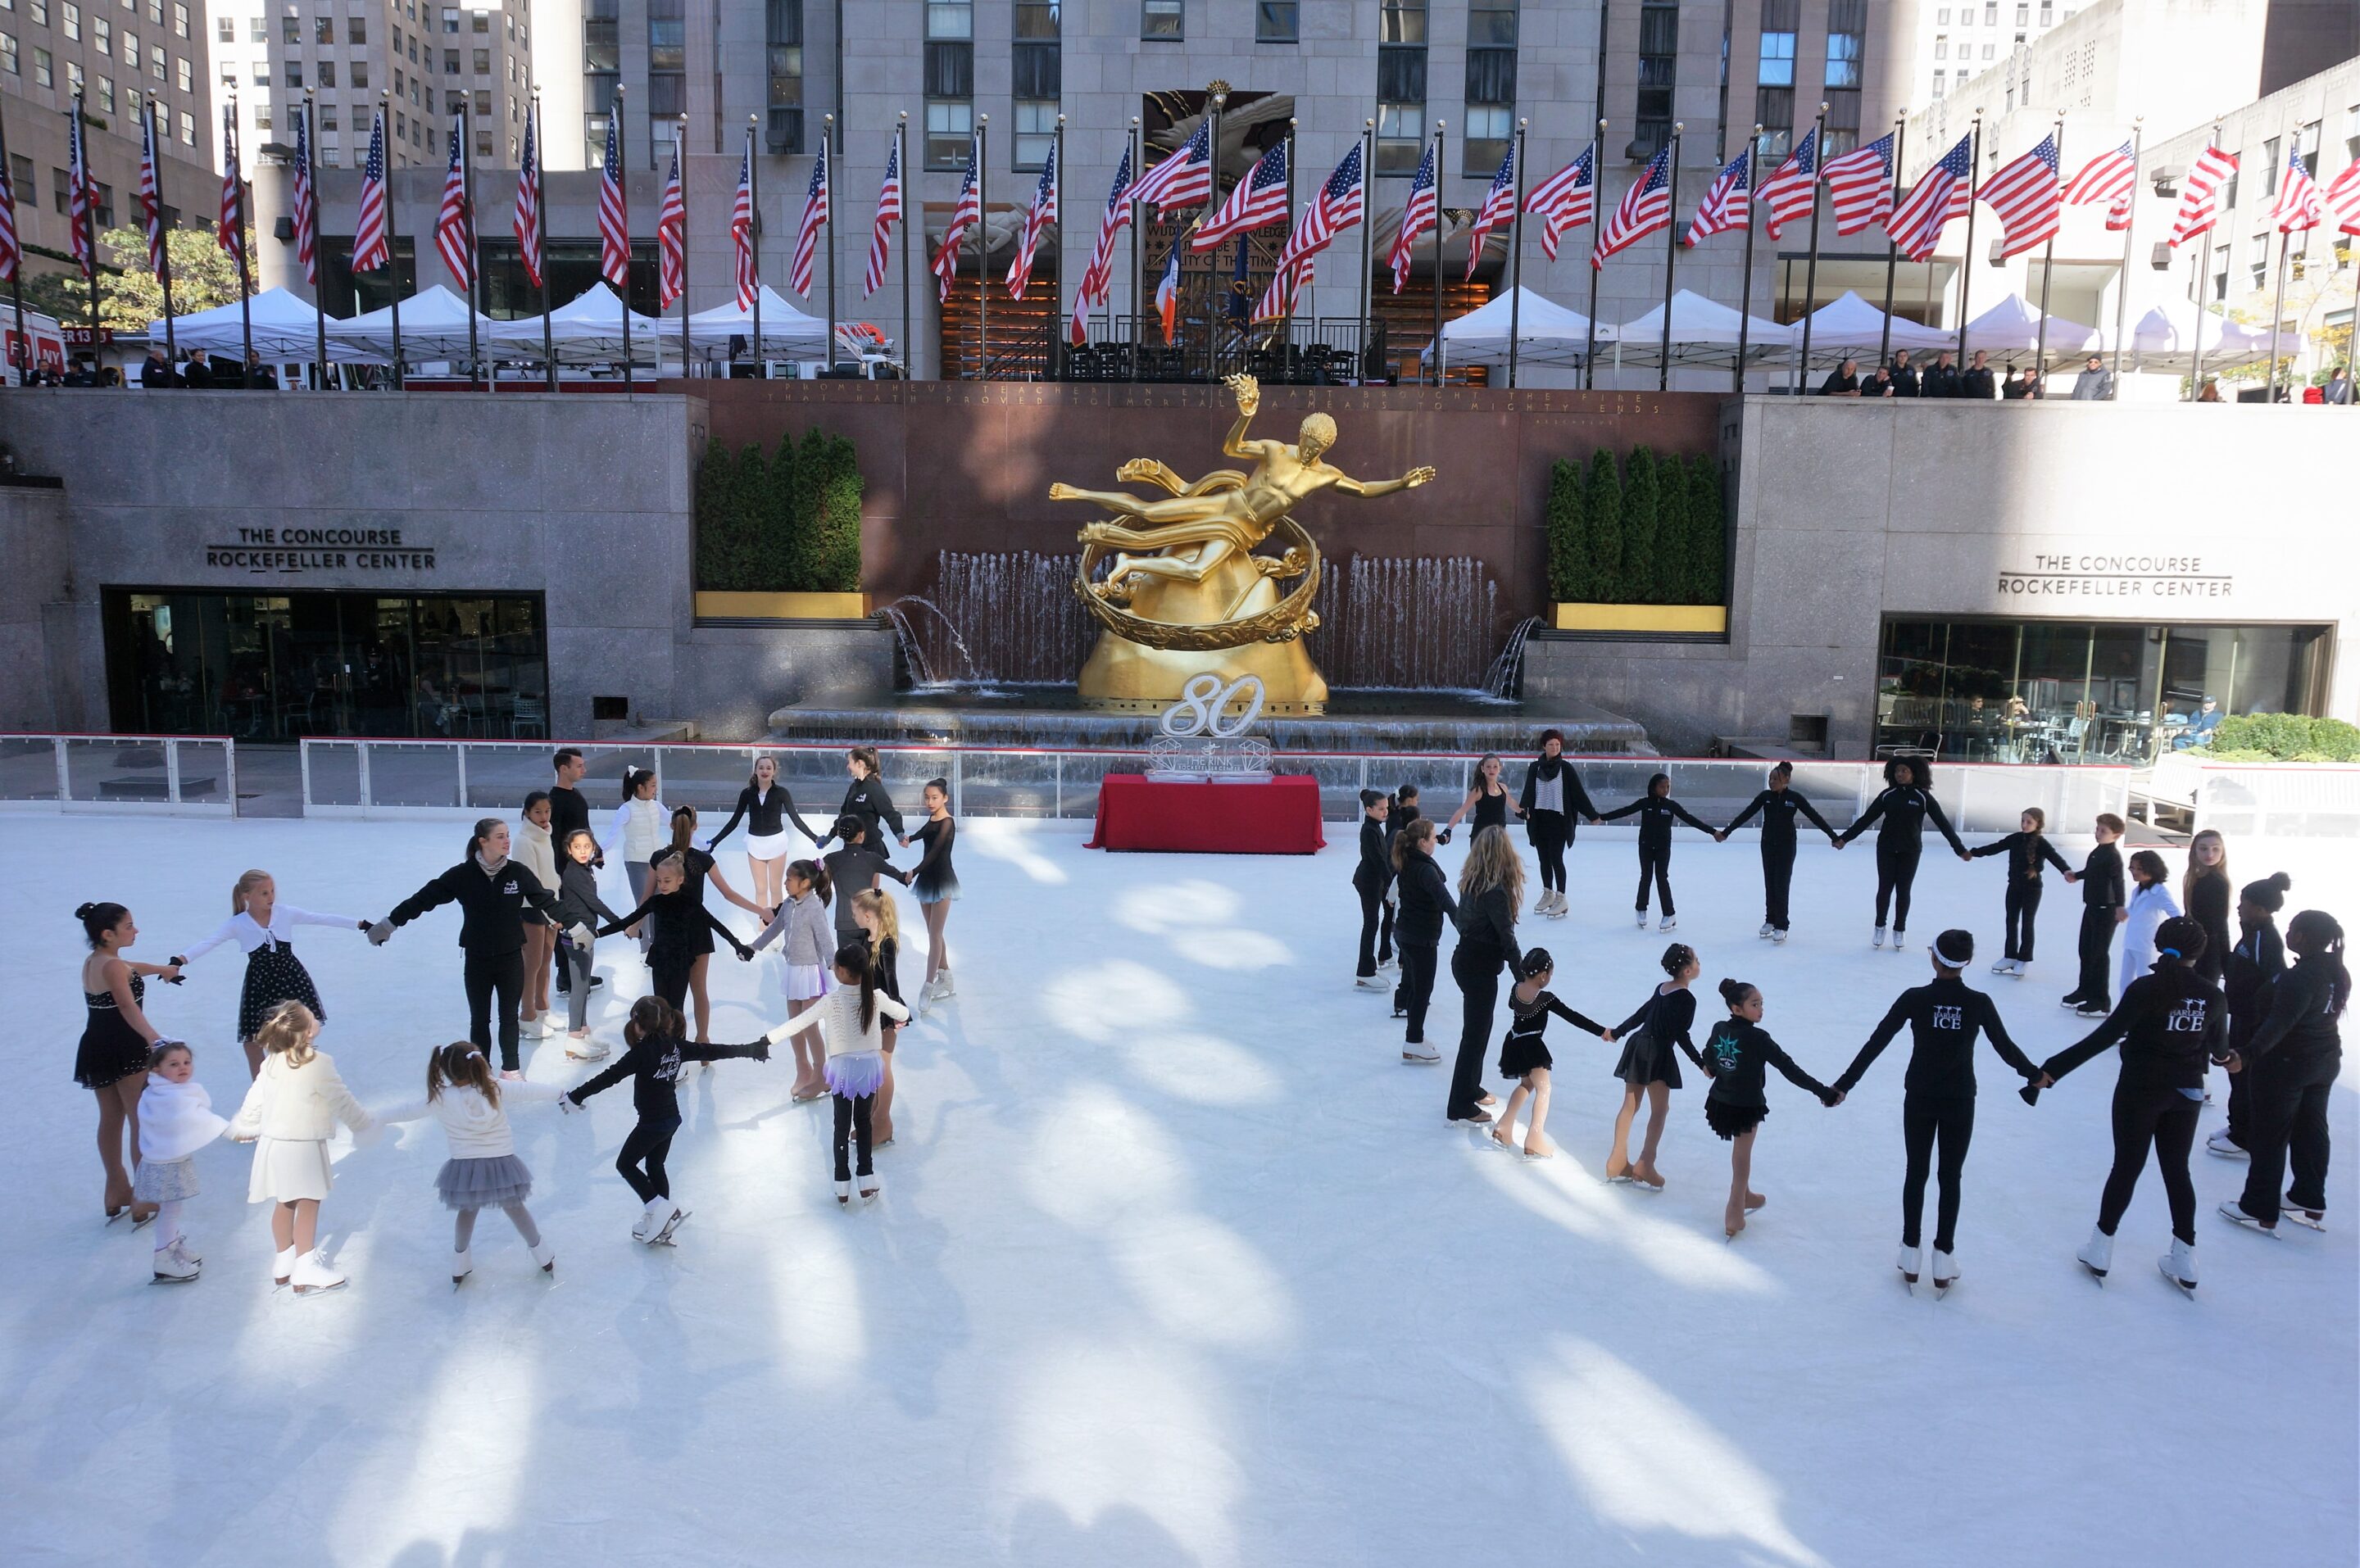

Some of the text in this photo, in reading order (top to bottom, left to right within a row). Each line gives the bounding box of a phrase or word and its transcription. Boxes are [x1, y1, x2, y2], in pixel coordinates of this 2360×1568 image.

[76, 329, 91, 342] 13
[43, 348, 60, 366] NY
[983, 386, 1097, 395] TEACHER
[1128, 387, 1151, 396] IN
[1182, 387, 1224, 397] EVE
[1290, 390, 1332, 399] ART
[1509, 392, 1551, 401] THE
[1582, 393, 1641, 402] FIRE
[767, 393, 826, 401] THAT
[856, 394, 916, 402] HATH
[946, 396, 1042, 405] PROVED
[1073, 397, 1098, 406] TO
[1126, 398, 1225, 407] MORTAL
[1308, 401, 1387, 410] MEANS
[1417, 401, 1442, 410] TO
[1471, 402, 1568, 412] MIGHTY
[1600, 404, 1659, 414] ENDS
[238, 528, 402, 545] THE CONCOURSE
[207, 551, 435, 569] ROCKEFELLER CENTER
[2036, 555, 2202, 572] THE CONCOURSE
[1998, 578, 2232, 596] ROCKEFELLER CENTER
[1160, 673, 1264, 737] 80
[1185, 755, 1233, 767] THE RINK
[1934, 1017, 1961, 1030] ICE
[2166, 1016, 2204, 1031] ICE
